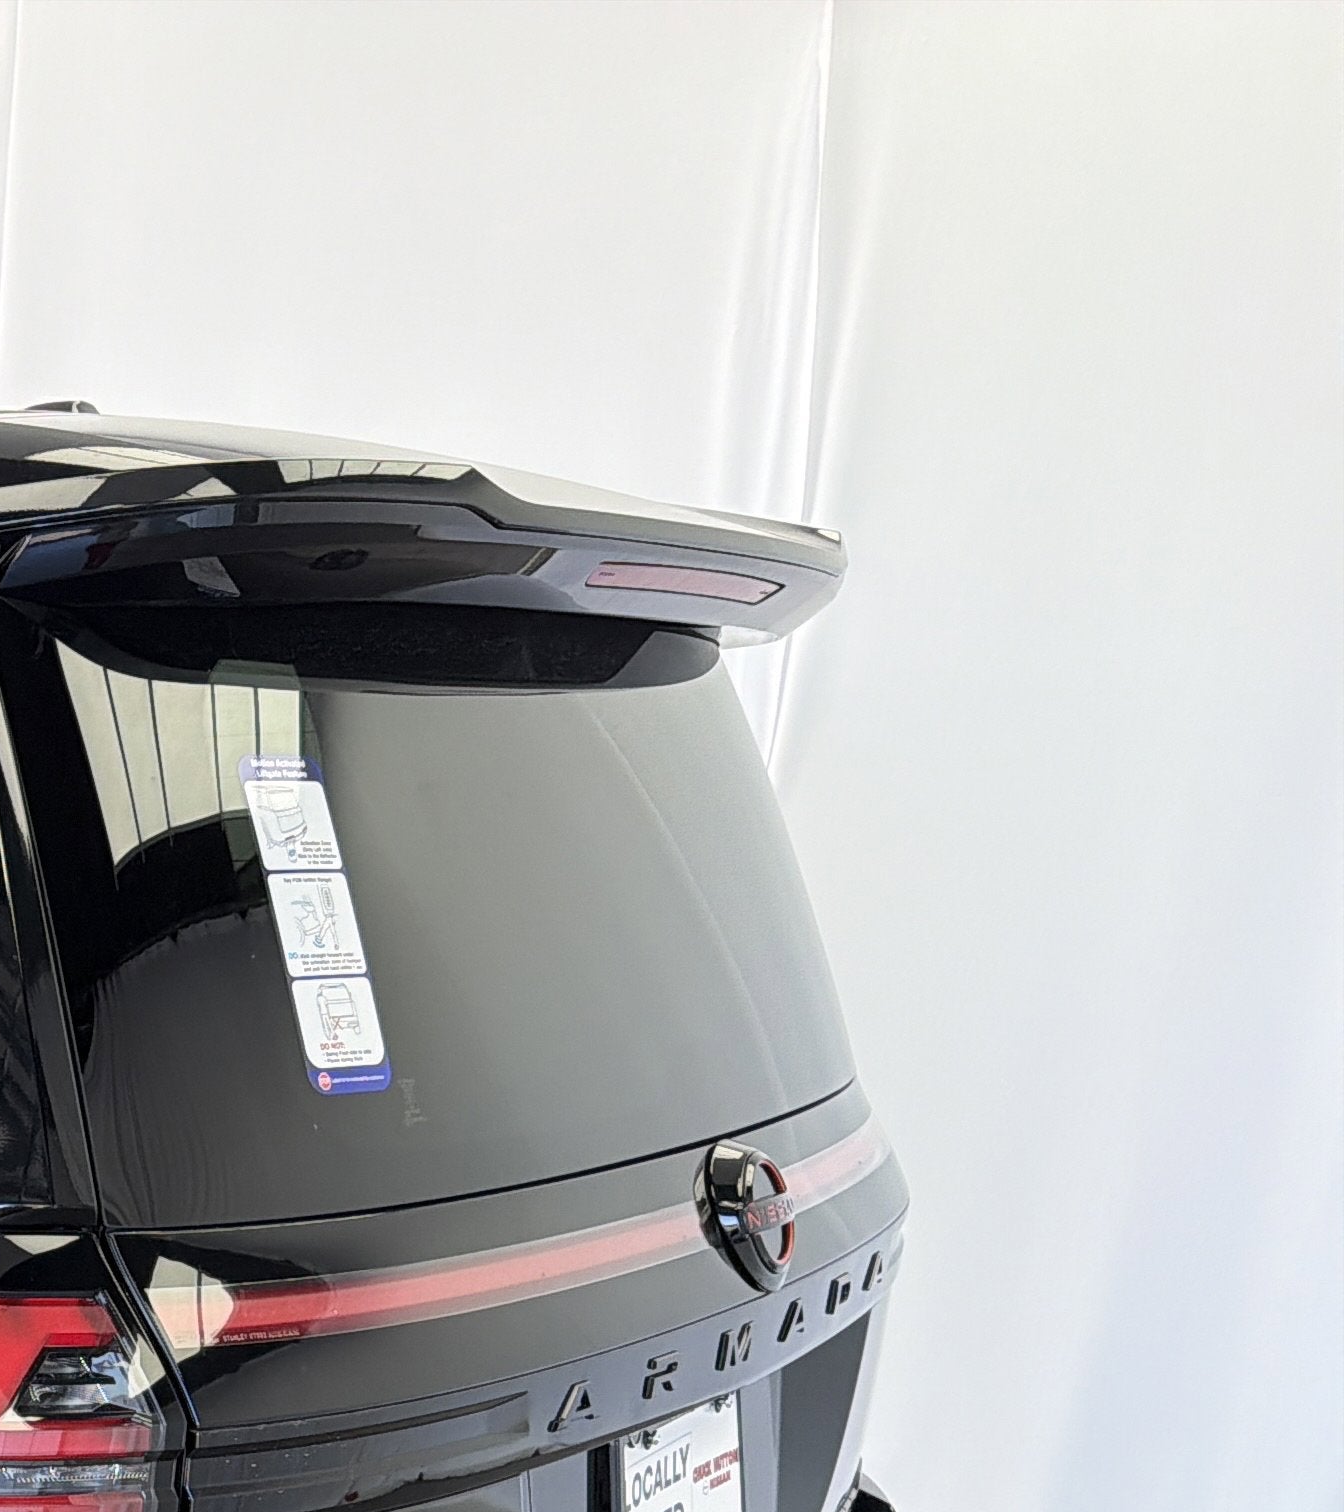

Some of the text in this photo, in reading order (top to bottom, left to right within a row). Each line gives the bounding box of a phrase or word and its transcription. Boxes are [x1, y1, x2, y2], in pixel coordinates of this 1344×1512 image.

[547, 1250, 884, 1433] ARMADA
[692, 1447, 739, 1484] CHUCK HUTTON
